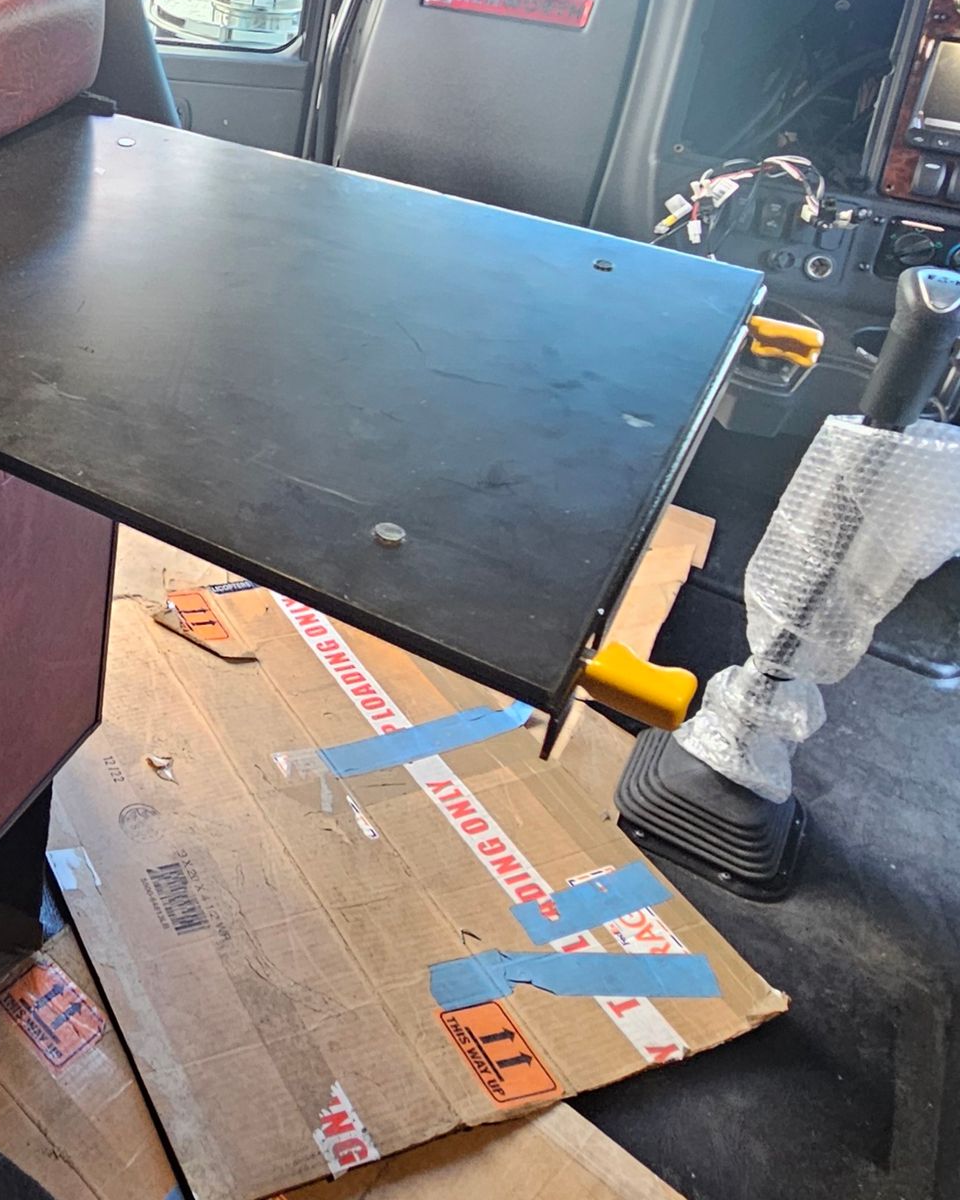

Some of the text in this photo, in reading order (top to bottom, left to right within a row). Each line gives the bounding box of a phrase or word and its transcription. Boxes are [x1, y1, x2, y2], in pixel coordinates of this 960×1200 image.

[316, 639, 396, 722] LOADING
[103, 756, 125, 783] 12/22
[426, 779, 490, 836] ONLY
[2, 992, 63, 1059] THIS WAY UP
[446, 1016, 506, 1096] THIS WAY UP
